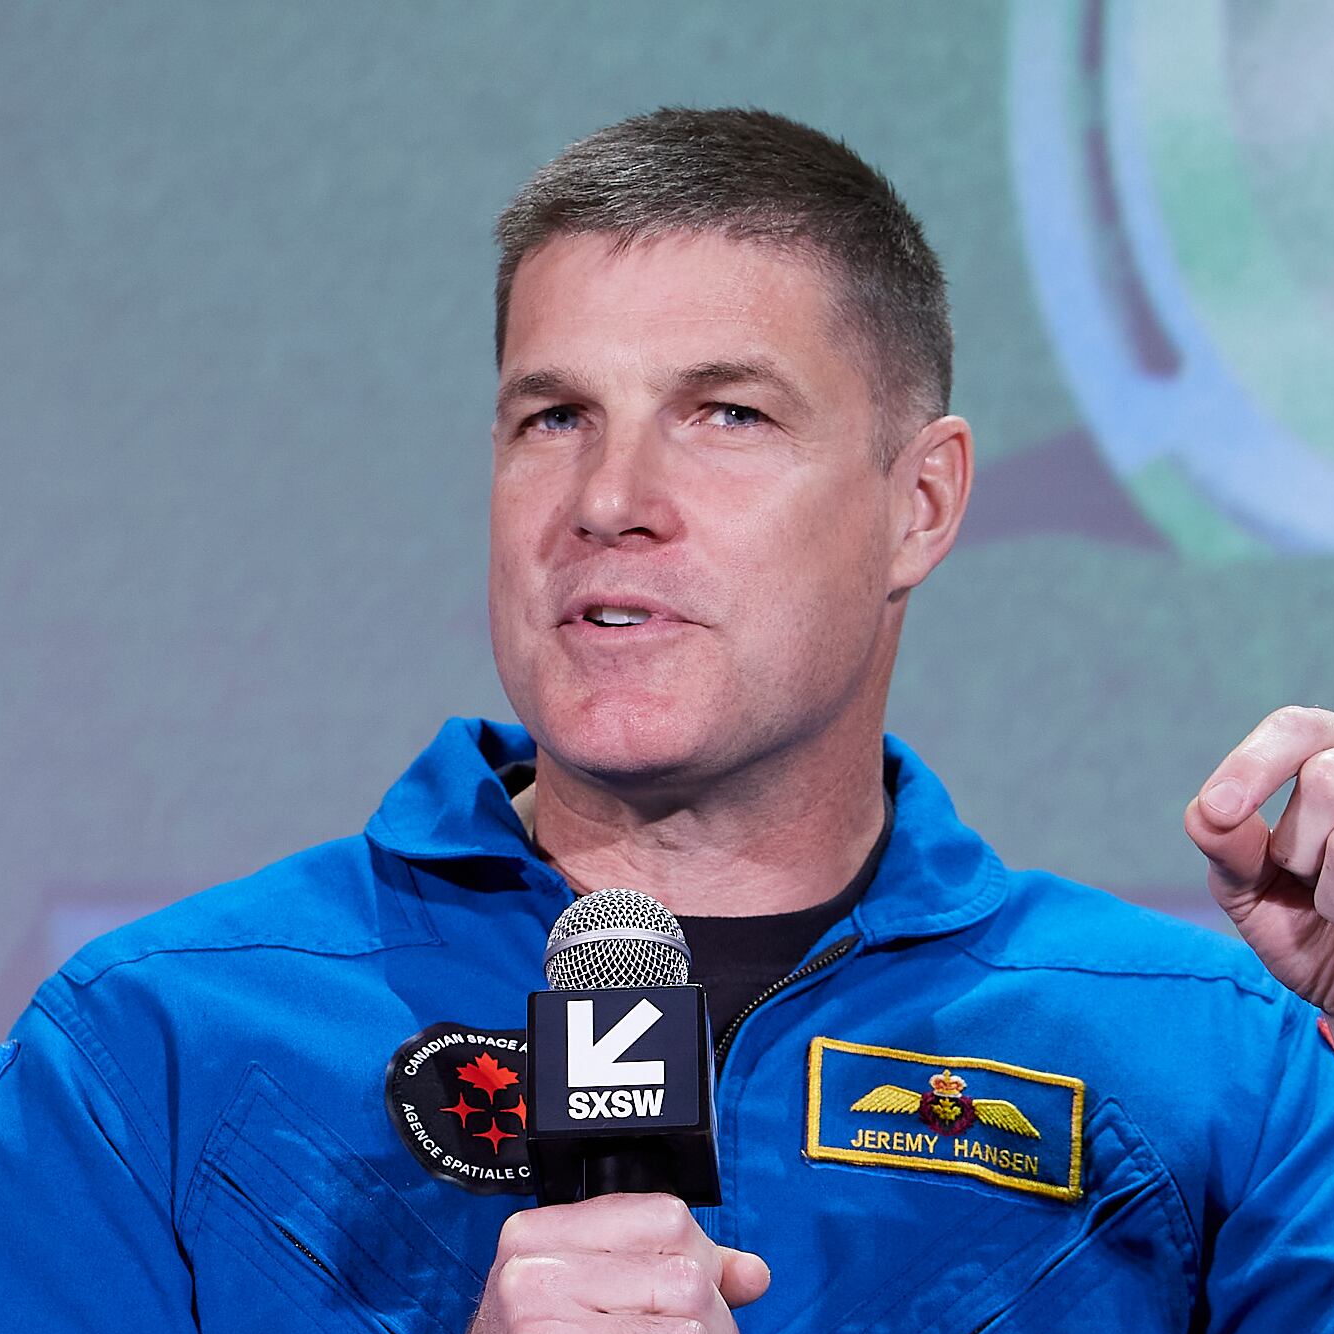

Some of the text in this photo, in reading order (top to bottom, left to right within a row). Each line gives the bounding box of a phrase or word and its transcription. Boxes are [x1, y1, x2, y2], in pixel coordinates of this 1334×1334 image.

[404, 1033, 465, 1076] CANADIAN
[467, 1034, 518, 1050] SPACE
[568, 1088, 665, 1120] SXSW
[402, 1103, 515, 1180] AGENCE SPATIALE
[850, 1128, 1039, 1175] JEREMY HANSEN
